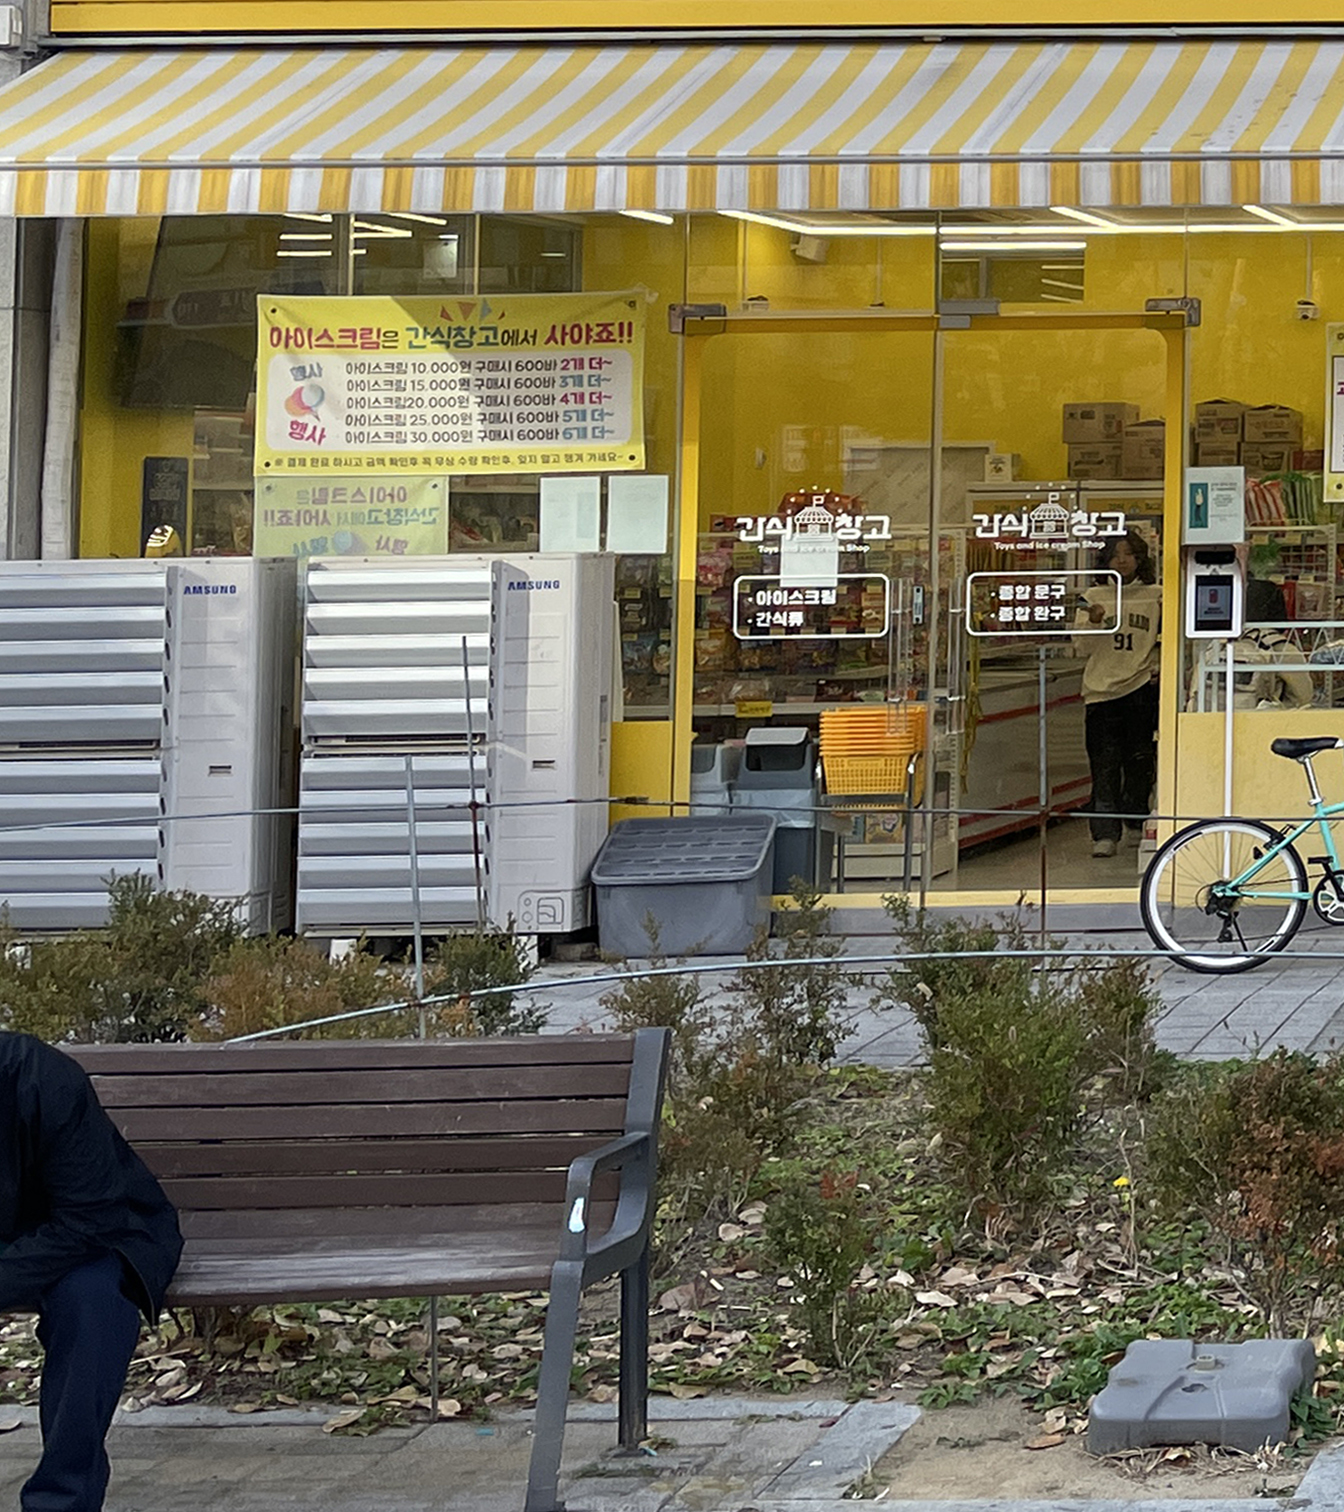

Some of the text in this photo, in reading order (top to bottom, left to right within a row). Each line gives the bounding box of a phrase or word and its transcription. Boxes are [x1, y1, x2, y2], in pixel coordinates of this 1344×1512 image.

[269, 321, 633, 350] 아이스크림은 간식창고에서 사야죠!!
[346, 362, 408, 375] 아이스크림
[474, 359, 512, 373] 구매시
[515, 358, 558, 372] 600바
[560, 357, 584, 371] 2개
[346, 379, 407, 392] 아이스크림
[473, 377, 511, 390] 구매시
[513, 376, 556, 389] 600바
[559, 374, 584, 388] 3개
[473, 395, 511, 408] 구매시
[513, 393, 556, 407] 600바
[559, 392, 585, 405] 4개
[346, 414, 407, 427] 아이스크림
[476, 412, 513, 425] 구매시
[516, 410, 559, 423] 600바
[562, 409, 588, 423] 5개
[288, 420, 326, 445] 행사
[346, 431, 407, 444] 아이스크림
[476, 429, 513, 442] 구매시
[516, 428, 559, 441] 600바
[562, 426, 588, 440] 6개
[736, 513, 892, 542] 간식 창고
[973, 510, 1128, 538] 간식 창고
[183, 584, 237, 596] AMSUNG
[507, 579, 560, 591] AMSUNG
[998, 584, 1031, 601] 종합
[755, 589, 837, 605] 아이스크림
[998, 605, 1031, 622] 종합
[1113, 632, 1134, 651] 91
